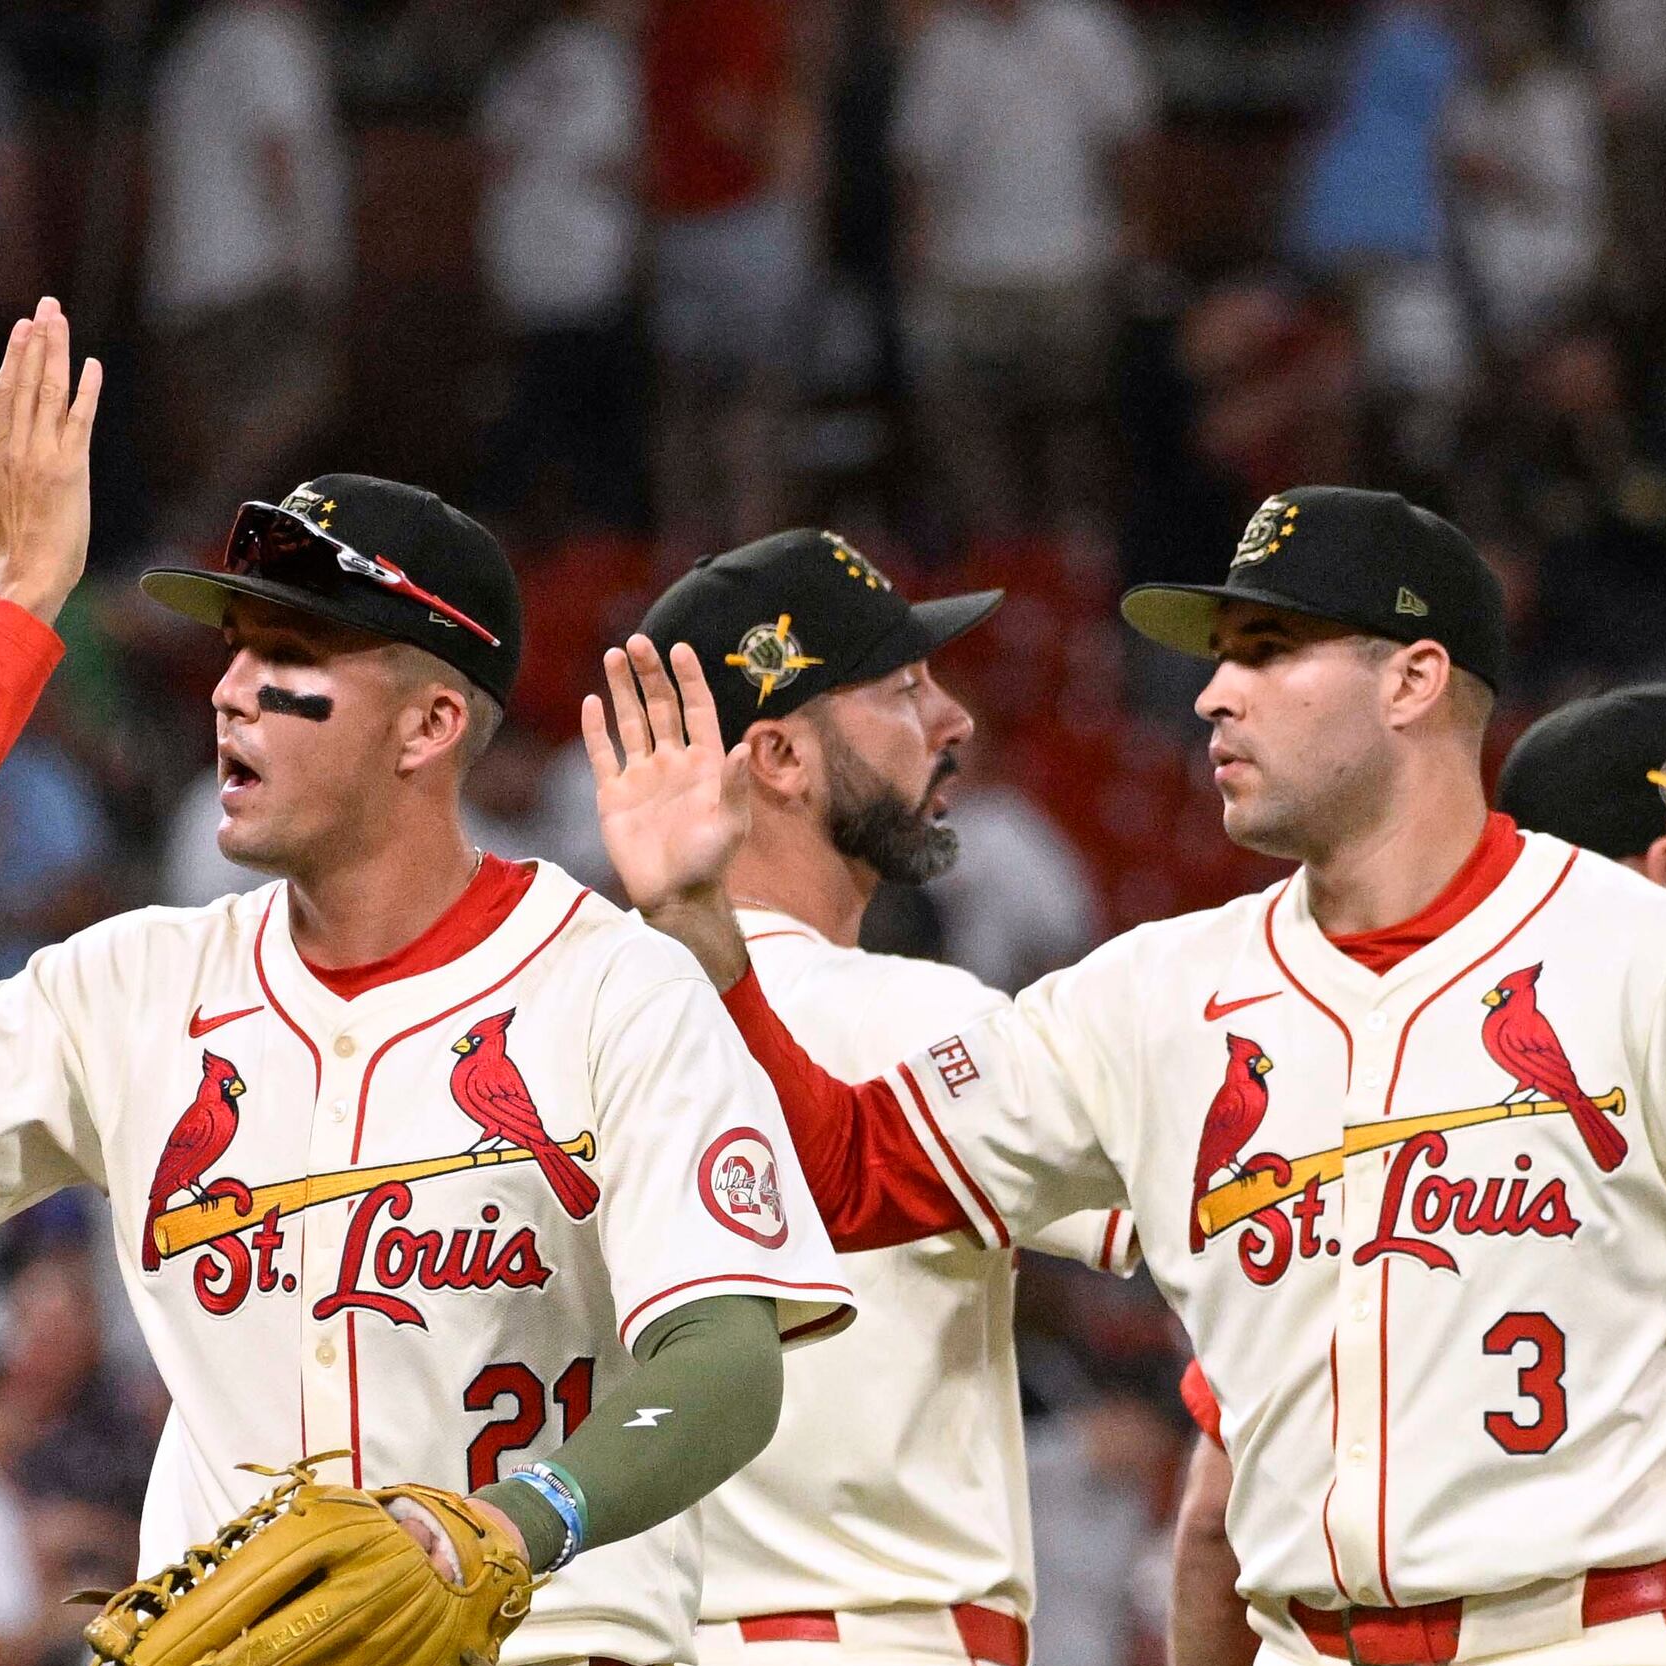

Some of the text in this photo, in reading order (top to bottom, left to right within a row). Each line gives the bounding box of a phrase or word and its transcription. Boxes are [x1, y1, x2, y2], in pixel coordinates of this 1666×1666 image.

[193, 1176, 554, 1332] St. Louis
[1238, 1130, 1582, 1287] St. Louis
[463, 1356, 596, 1495] 21
[1482, 1311, 1569, 1456] 3
